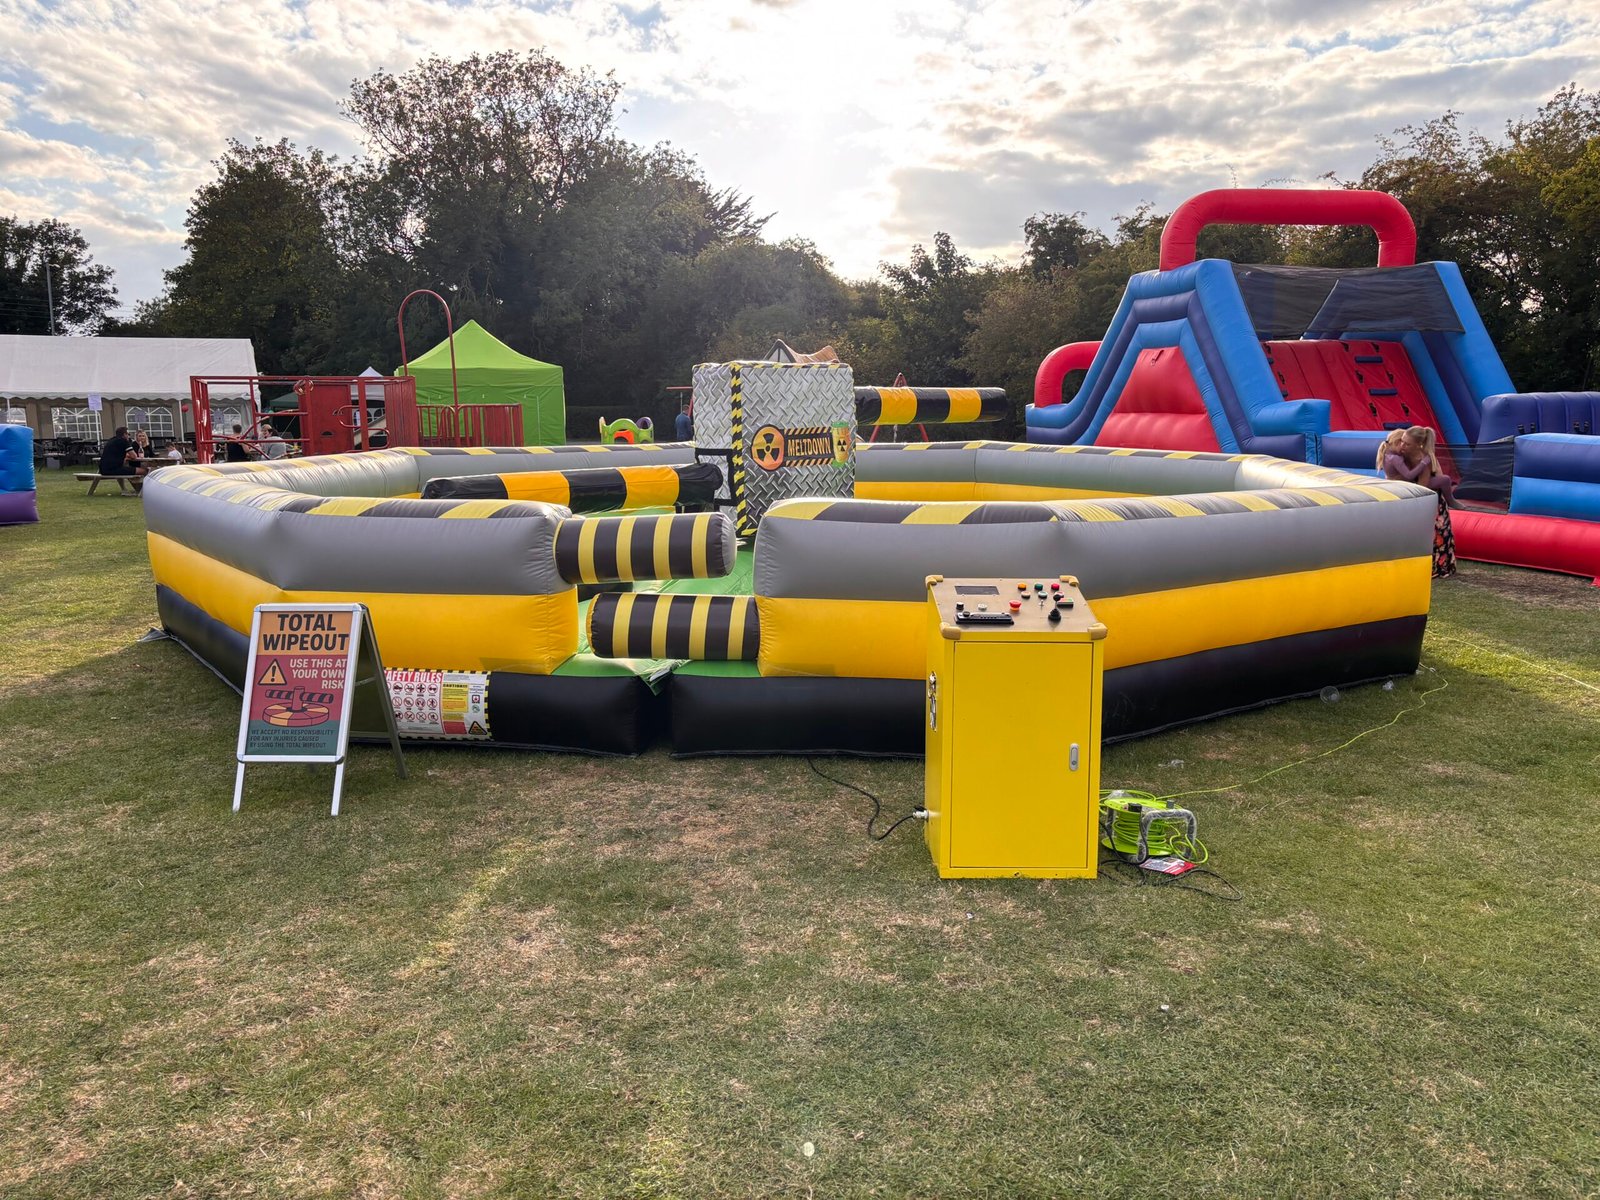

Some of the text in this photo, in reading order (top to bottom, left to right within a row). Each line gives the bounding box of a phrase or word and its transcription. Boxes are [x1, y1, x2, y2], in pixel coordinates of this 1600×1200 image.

[787, 437, 832, 457] MELTDOWN
[278, 613, 337, 631] TOTAL
[263, 633, 350, 651] WIPEOUT
[290, 658, 347, 668] USE THIS AT
[292, 669, 345, 679] YOUR OWN
[414, 671, 442, 683] RULES
[321, 679, 345, 689] RISK
